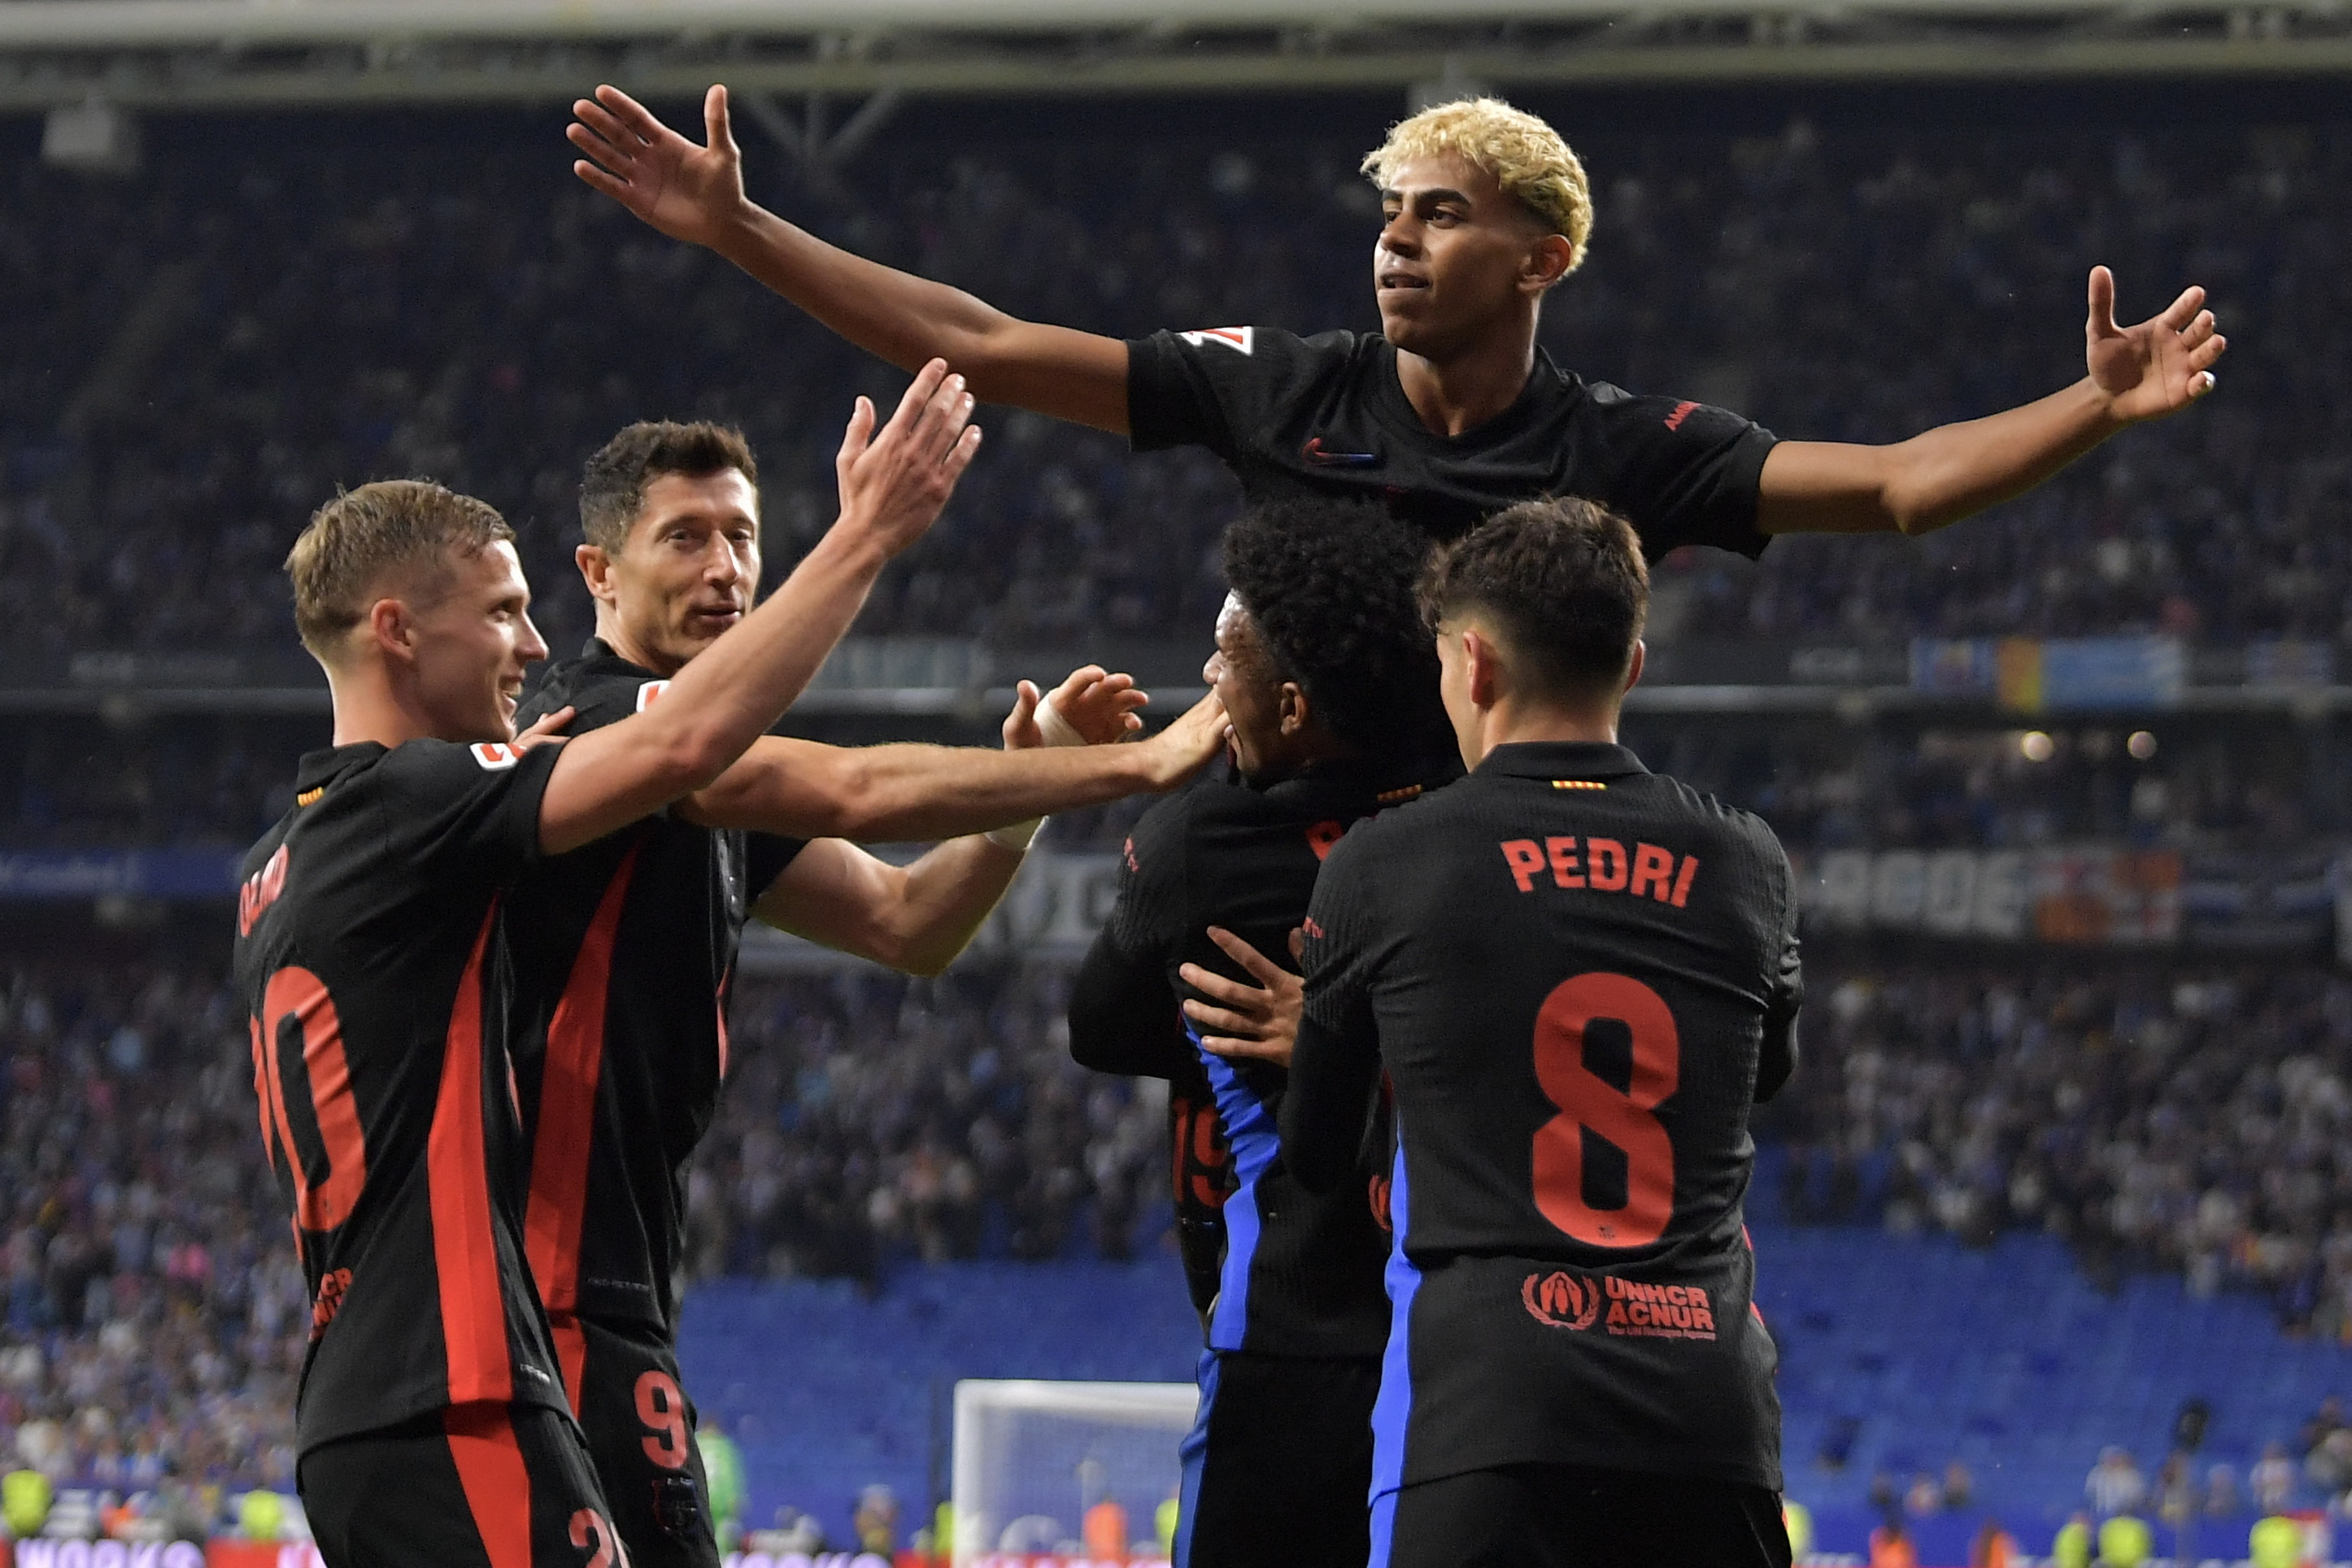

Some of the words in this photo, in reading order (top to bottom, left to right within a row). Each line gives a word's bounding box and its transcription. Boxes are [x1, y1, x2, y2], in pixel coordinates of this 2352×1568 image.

[1500, 836, 1699, 908] PEDRI
[250, 965, 367, 1262] 0
[1532, 972, 1679, 1248] 8
[1605, 1274, 1709, 1308] UNHCR
[1606, 1301, 1714, 1331] ACNUR
[634, 1370, 688, 1469] 9
